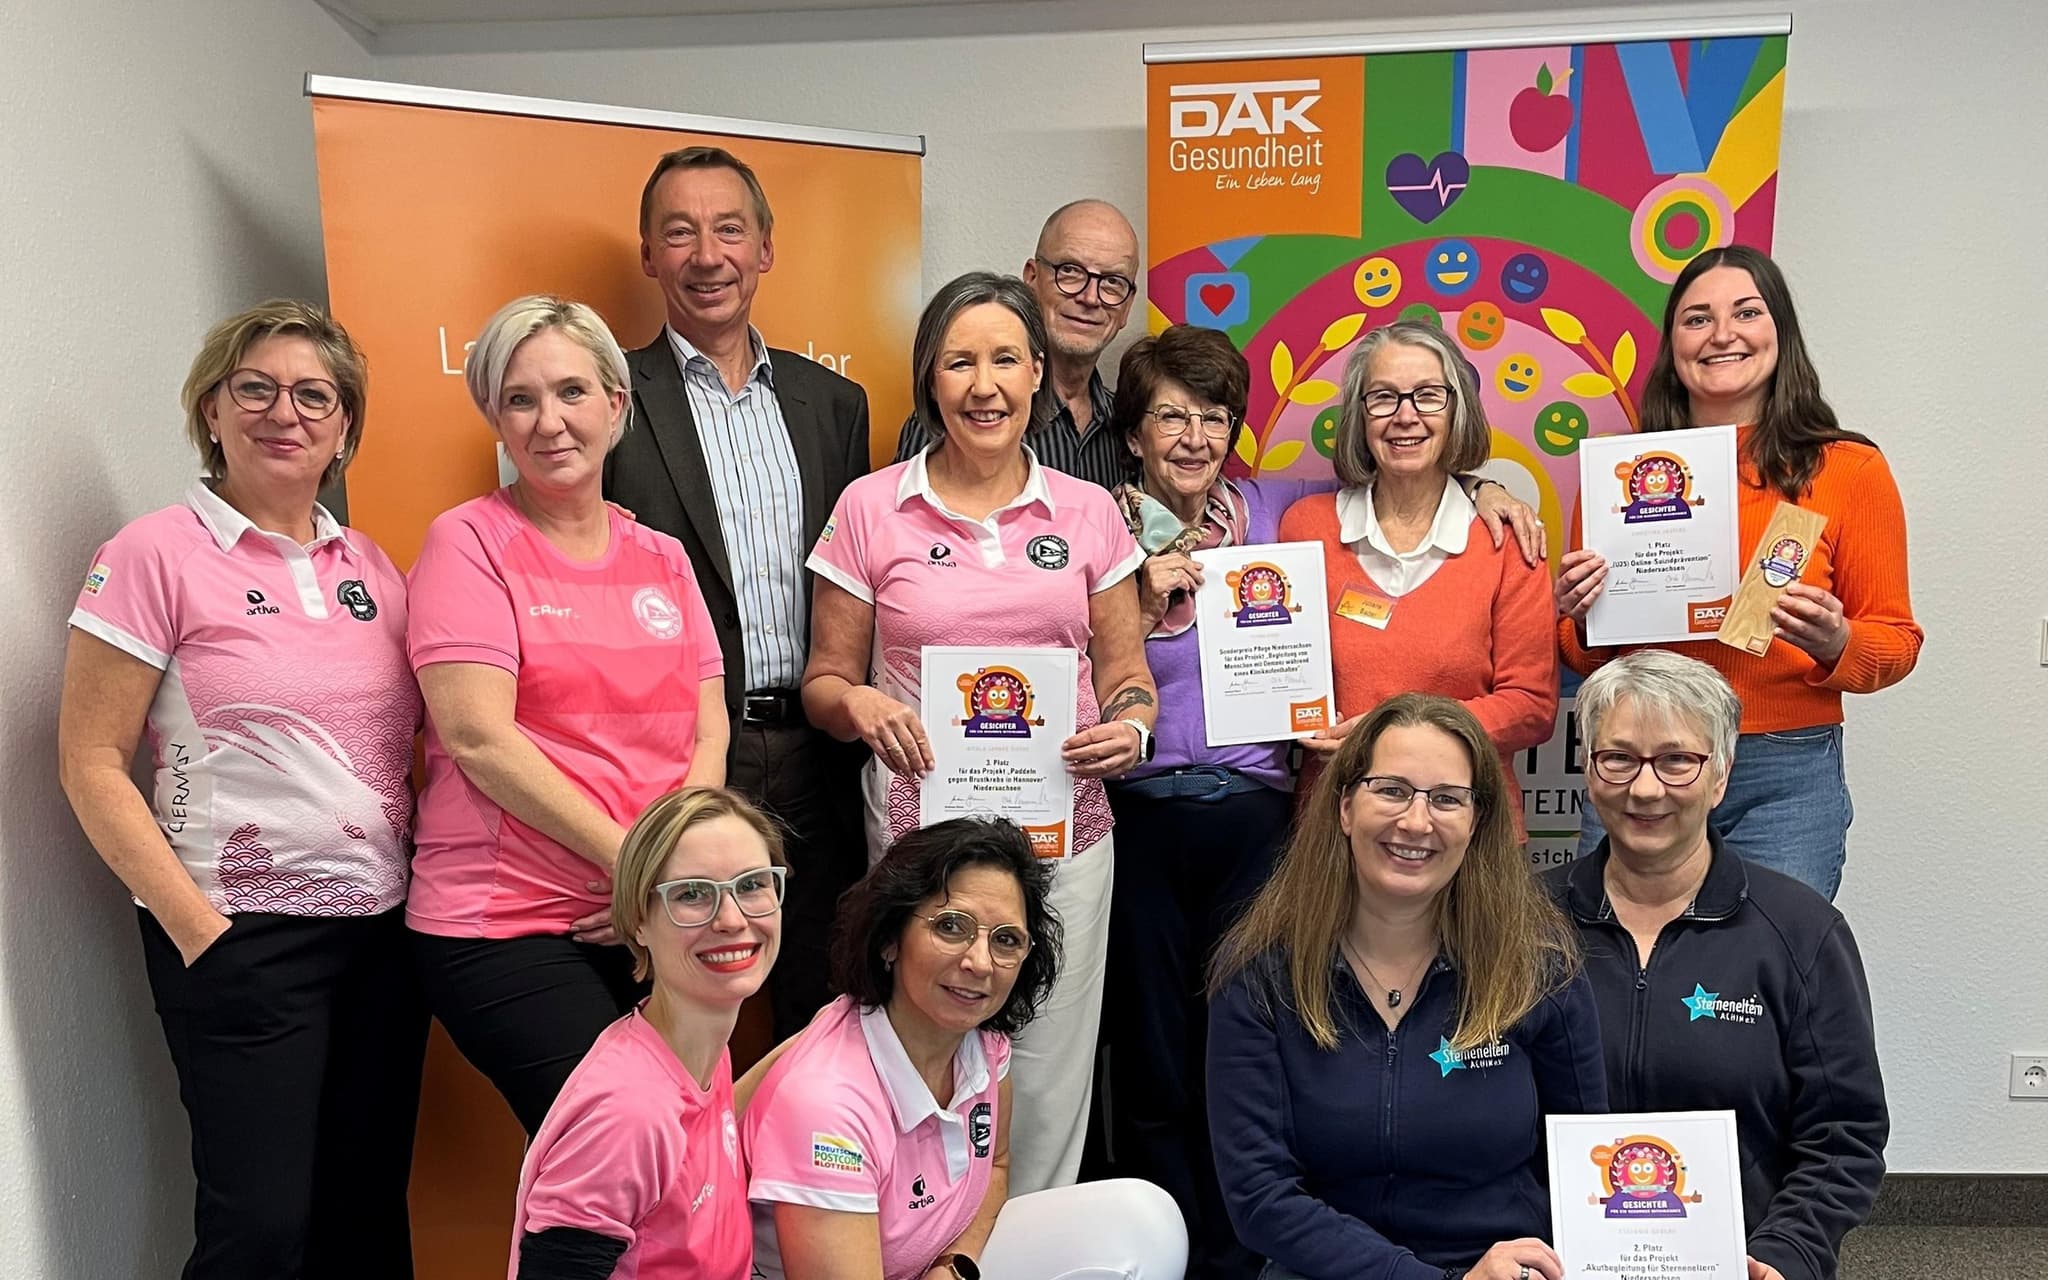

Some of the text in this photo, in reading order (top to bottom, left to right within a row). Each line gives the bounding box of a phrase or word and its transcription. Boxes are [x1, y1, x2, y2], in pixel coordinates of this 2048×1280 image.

[1170, 79, 1323, 138] DAK
[1169, 136, 1323, 172] Gesundheit
[1215, 173, 1241, 190] Ein
[1245, 171, 1285, 190] Leben
[1635, 565, 1686, 574] Niedersachsen
[1694, 607, 1726, 619] DAK
[1295, 706, 1323, 719] DAK
[958, 767, 968, 775] für
[969, 767, 981, 775] das
[982, 767, 1006, 776] Projekt
[947, 776, 968, 784] gegen
[1531, 848, 1573, 864] sich
[1622, 1200, 1668, 1209] GESICHTER
[1633, 1243, 1664, 1252] 2. Platz
[1620, 1254, 1679, 1264] für das Projekt
[1647, 1263, 1659, 1272] für
